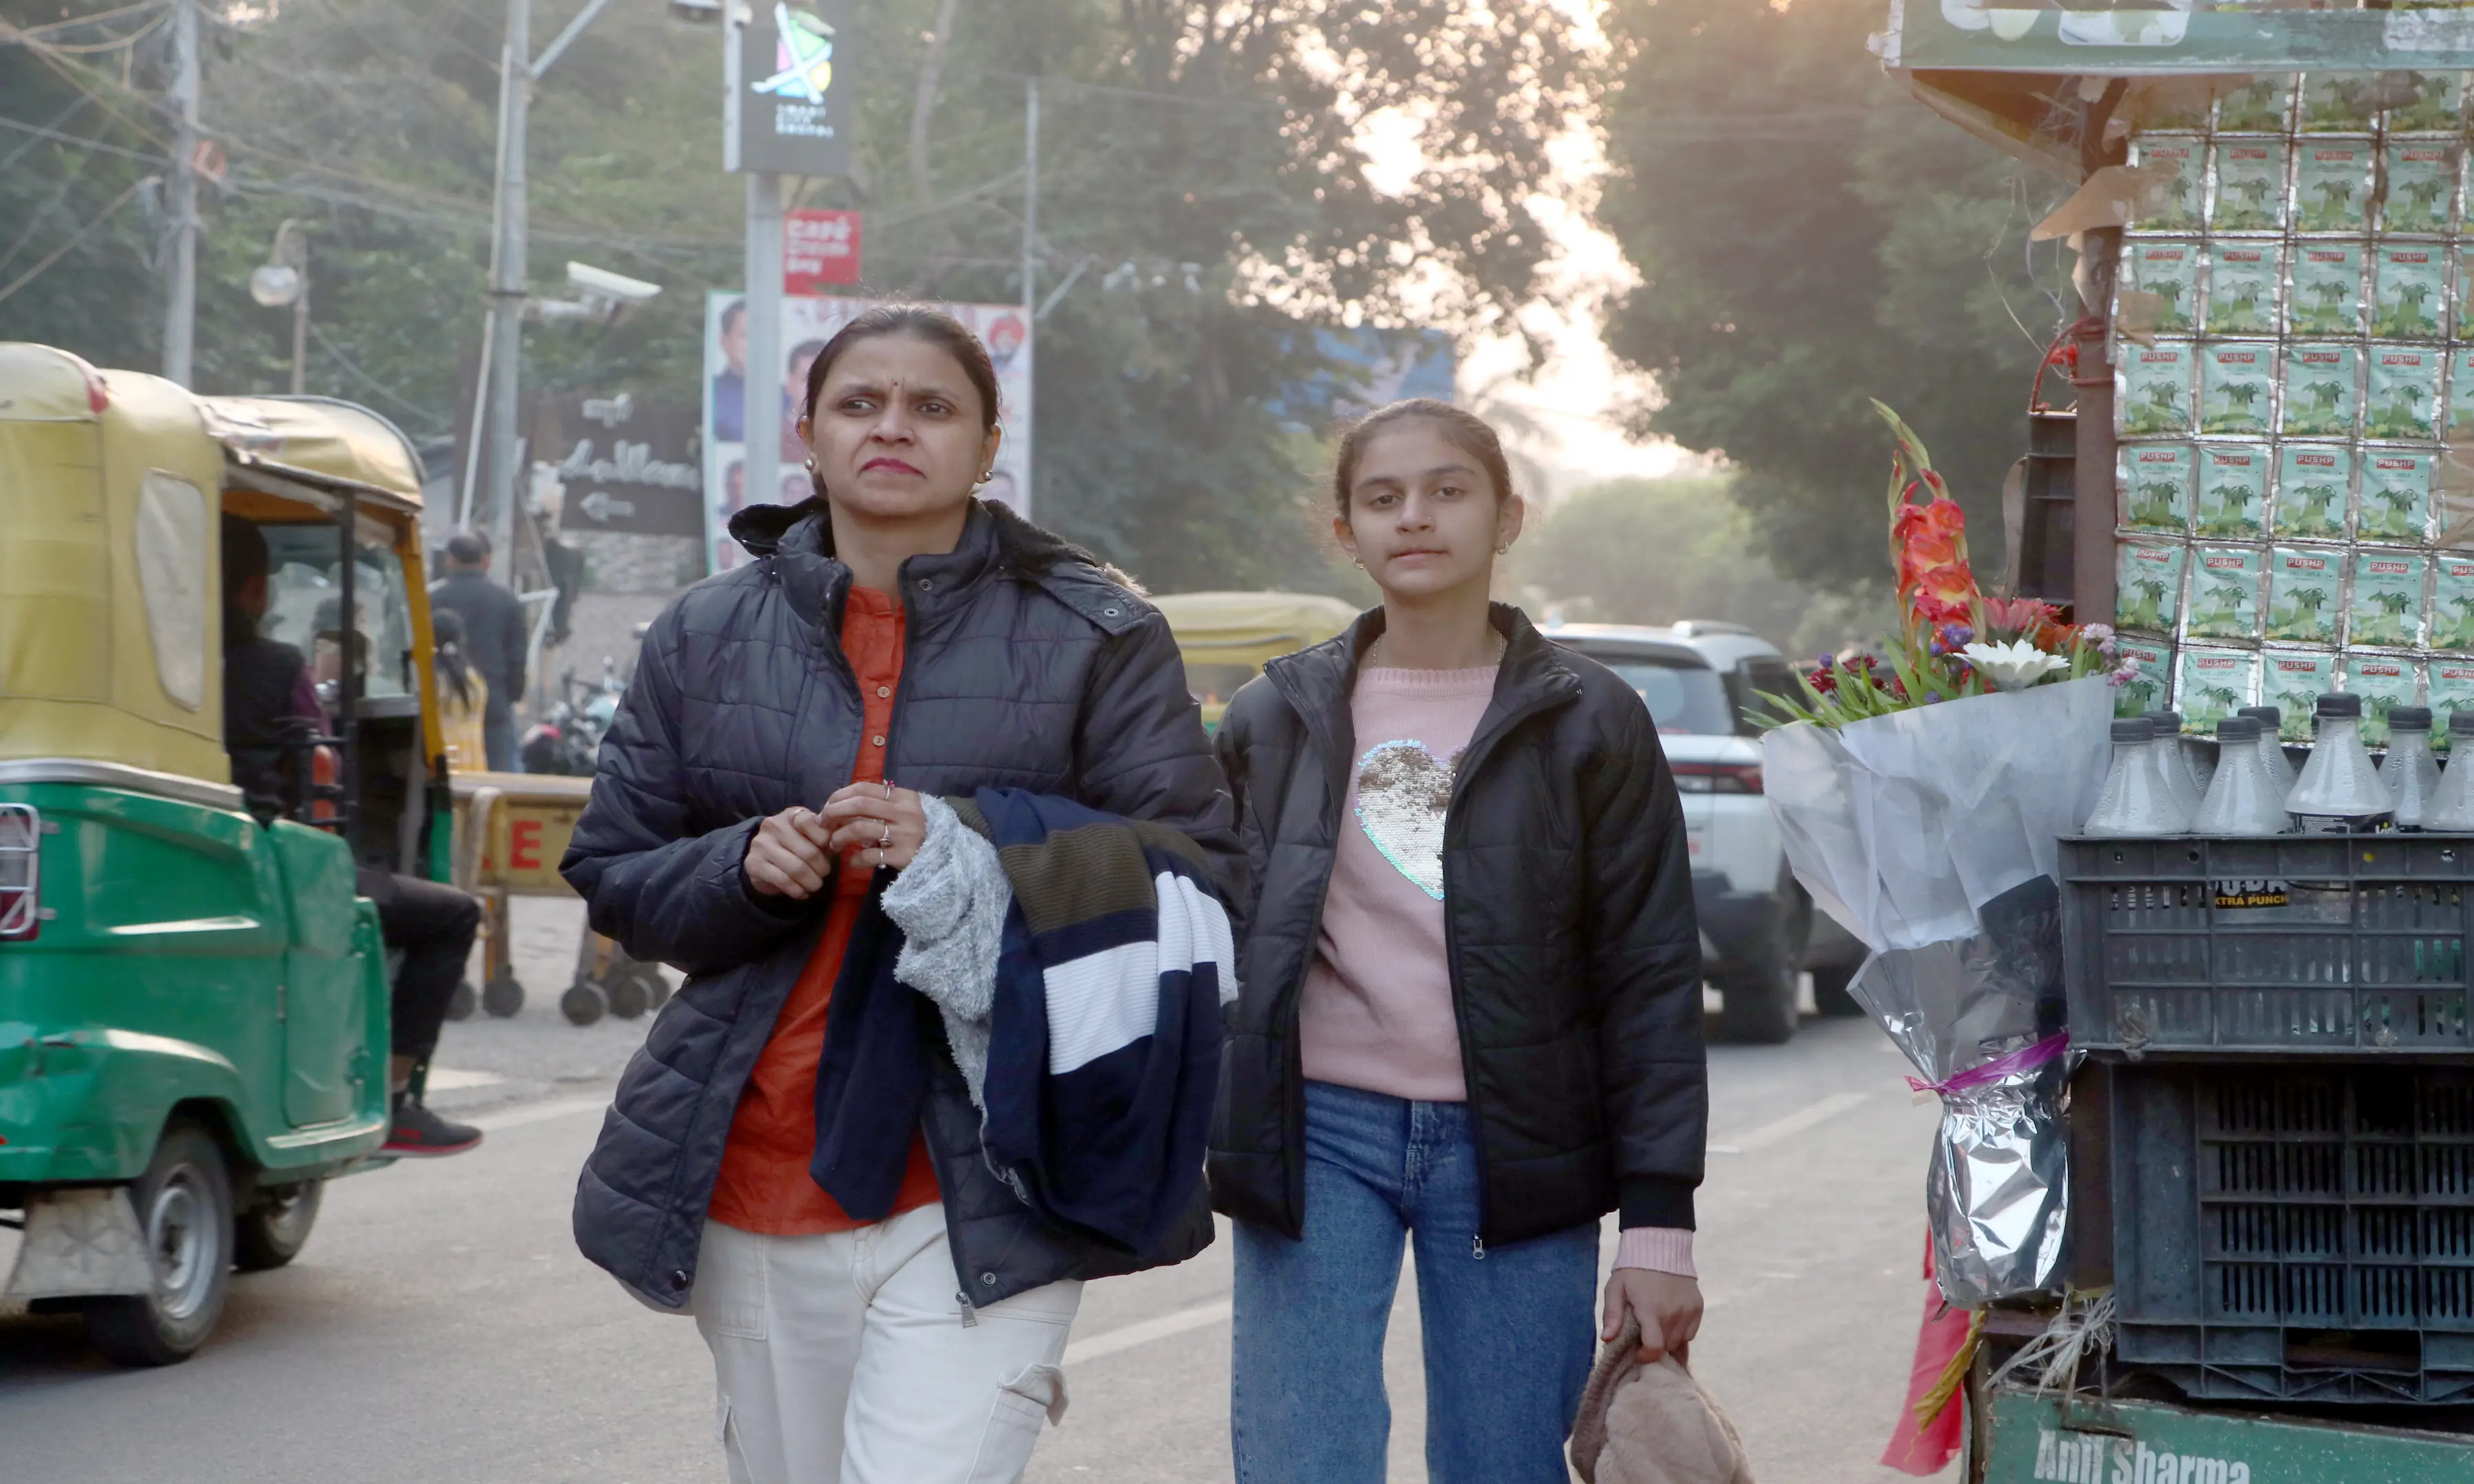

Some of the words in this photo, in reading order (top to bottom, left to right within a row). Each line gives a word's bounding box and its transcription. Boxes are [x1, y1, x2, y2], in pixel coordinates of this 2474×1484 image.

[2141, 352, 2176, 360] PUSHP
[2218, 352, 2254, 361] PUSHP
[2304, 352, 2339, 361] PUSHP
[2214, 456, 2249, 464] PUSHP
[2297, 456, 2333, 464] PUSHP
[2137, 549, 2169, 559] PUSHP
[2207, 558, 2242, 567] PUSHP
[2288, 559, 2323, 567] PUSHP
[2372, 562, 2407, 571] PUSHP
[2198, 659, 2234, 667] PUSHP
[2362, 665, 2398, 673] PUSHP
[2247, 895, 2288, 905] PUNCH
[2033, 1430, 2105, 1484] Anil
[2112, 1437, 2251, 1484] Sharma
